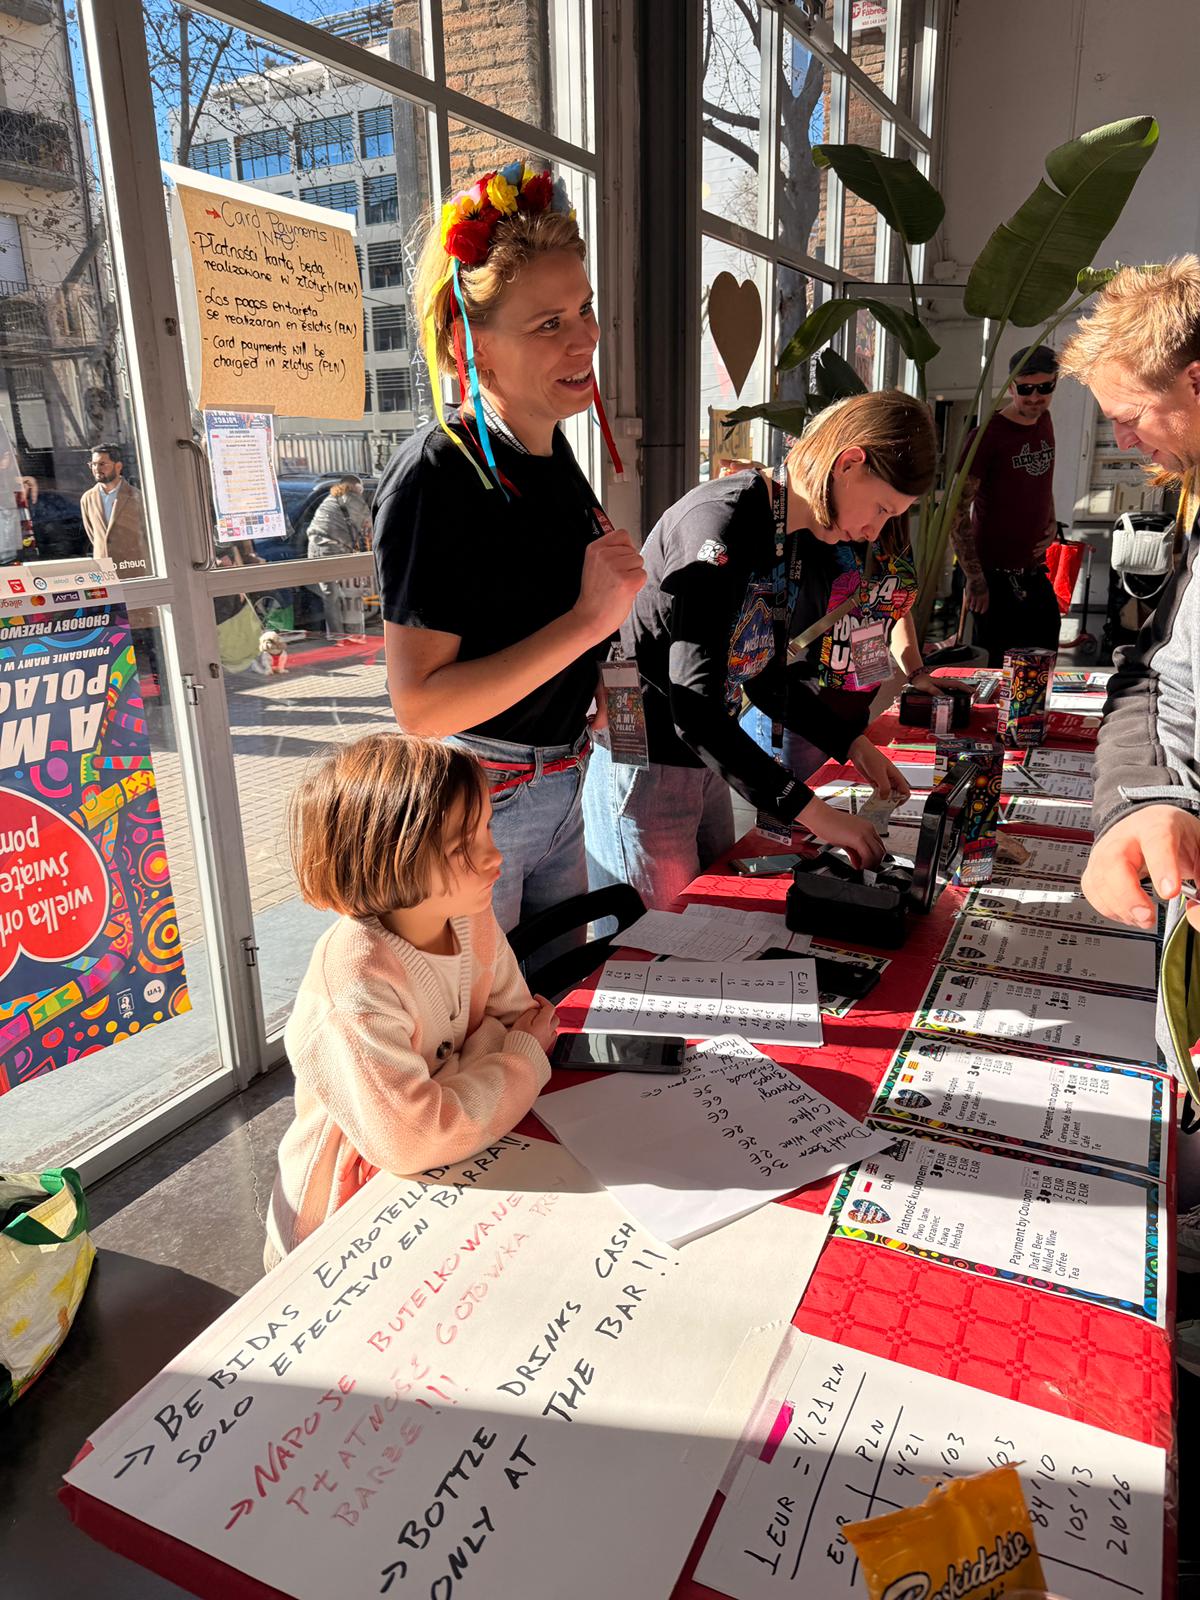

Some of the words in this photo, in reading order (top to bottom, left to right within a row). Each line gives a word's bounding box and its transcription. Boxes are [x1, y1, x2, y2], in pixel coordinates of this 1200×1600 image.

[220, 201, 261, 228] Card
[267, 211, 328, 243] Payments
[204, 258, 273, 283] realizowane
[280, 276, 290, 285] w
[334, 281, 359, 300] (PLN)
[205, 287, 230, 305] Los
[235, 297, 269, 317] pagos
[206, 308, 220, 321] se
[286, 320, 298, 331] en
[212, 335, 236, 350] Card
[241, 340, 287, 360] payments
[293, 341, 307, 357] will
[313, 344, 327, 359] be
[213, 355, 259, 377] charged
[265, 358, 275, 368] in
[282, 358, 314, 380] zlotys
[318, 358, 346, 383] (PLN)
[54, 613, 111, 633] CHOROBY
[17, 656, 50, 670] MAMY
[52, 646, 110, 663] POMAGANIE
[4, 663, 15, 672] W
[69, 701, 105, 752] A
[28, 885, 94, 934] wielka
[147, 986, 162, 996] tvn
[797, 971, 809, 994] EUR
[752, 1071, 788, 1087] Bigos
[922, 1070, 935, 1083] BAR
[692, 1083, 713, 1099] 5€
[701, 1095, 723, 1109] 6€
[757, 1079, 802, 1103] Pierogi
[788, 1092, 818, 1105] Tea
[707, 1108, 730, 1124] 6€
[787, 1102, 831, 1126] Coffee
[938, 1101, 953, 1117] Pago
[955, 1100, 969, 1121] Cerveza
[966, 1111, 977, 1122] Vino
[809, 1116, 848, 1139] Mulled
[778, 1133, 808, 1150] Wine
[881, 1173, 896, 1191] BAR
[1041, 1175, 1053, 1189] EUR
[1053, 1177, 1066, 1192] EUR
[896, 1196, 917, 1236] Płatność
[911, 1164, 929, 1201] kuponem
[912, 1222, 927, 1240] Piwo
[936, 1152, 948, 1167] EUR
[925, 1215, 941, 1243] Grzaniec
[947, 1154, 959, 1168] EUR
[937, 1227, 951, 1246] Kawa
[959, 1157, 970, 1170] EUR
[949, 1222, 965, 1250] Herbata
[970, 1160, 981, 1173] EUR
[1018, 1189, 1034, 1216] Coupon
[1015, 1216, 1031, 1228] by
[1055, 1252, 1068, 1277] Coffee
[1065, 1180, 1077, 1195] EUR
[1068, 1266, 1080, 1280] Tea
[1078, 1182, 1089, 1198] EUR
[1009, 1227, 1027, 1266] Payment
[1032, 1232, 1044, 1250] Beer
[1046, 1229, 1058, 1247] Wine
[367, 1192, 525, 1353] BUTELKOWANE
[1029, 1251, 1040, 1270] Draft
[1042, 1248, 1056, 1274] Mulled
[154, 1304, 300, 1442] BEBIDAS
[313, 1163, 451, 1290] EMBOTELLAD
[496, 1300, 582, 1397] DRINKS
[595, 1222, 636, 1278] CASH
[176, 1395, 254, 1473] SOLO
[269, 1255, 393, 1377] EFECTIVO
[397, 1217, 429, 1250] EN
[430, 1506, 495, 1600] ONLY
[504, 1434, 536, 1490] AT
[542, 1358, 595, 1422] THE
[743, 1549, 782, 1576] 1
[766, 1496, 796, 1548] EUR
[822, 1362, 846, 1393] PLN
[827, 1514, 852, 1565] EUR
[855, 1419, 885, 1463] PLN
